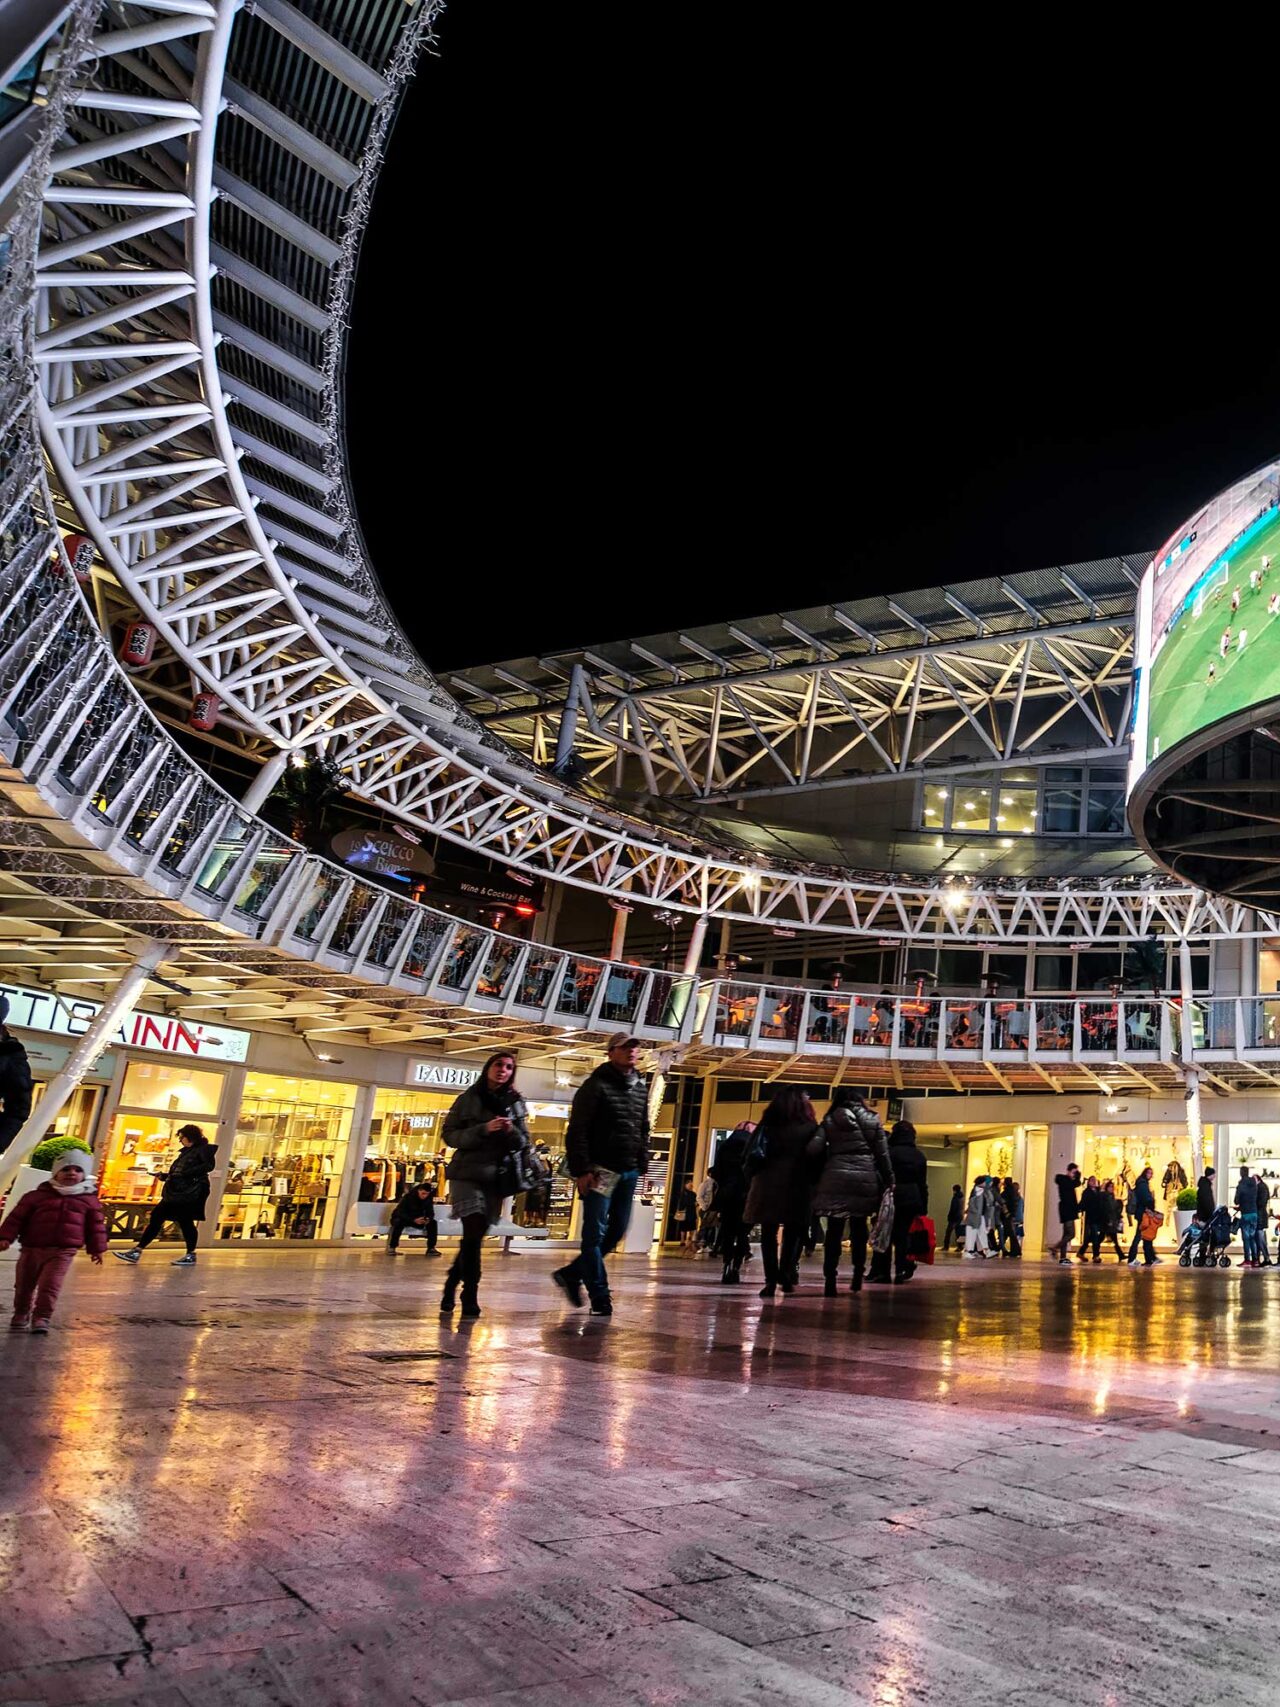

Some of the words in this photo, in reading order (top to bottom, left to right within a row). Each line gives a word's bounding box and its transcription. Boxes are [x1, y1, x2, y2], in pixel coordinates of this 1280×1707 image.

[361, 832, 414, 861] Sceicco
[461, 883, 479, 894] Wine
[480, 887, 486, 895] &
[487, 888, 517, 901] Cocktail
[131, 1015, 203, 1054] INN
[1130, 1145, 1161, 1159] nym
[1235, 1147, 1266, 1160] nym
